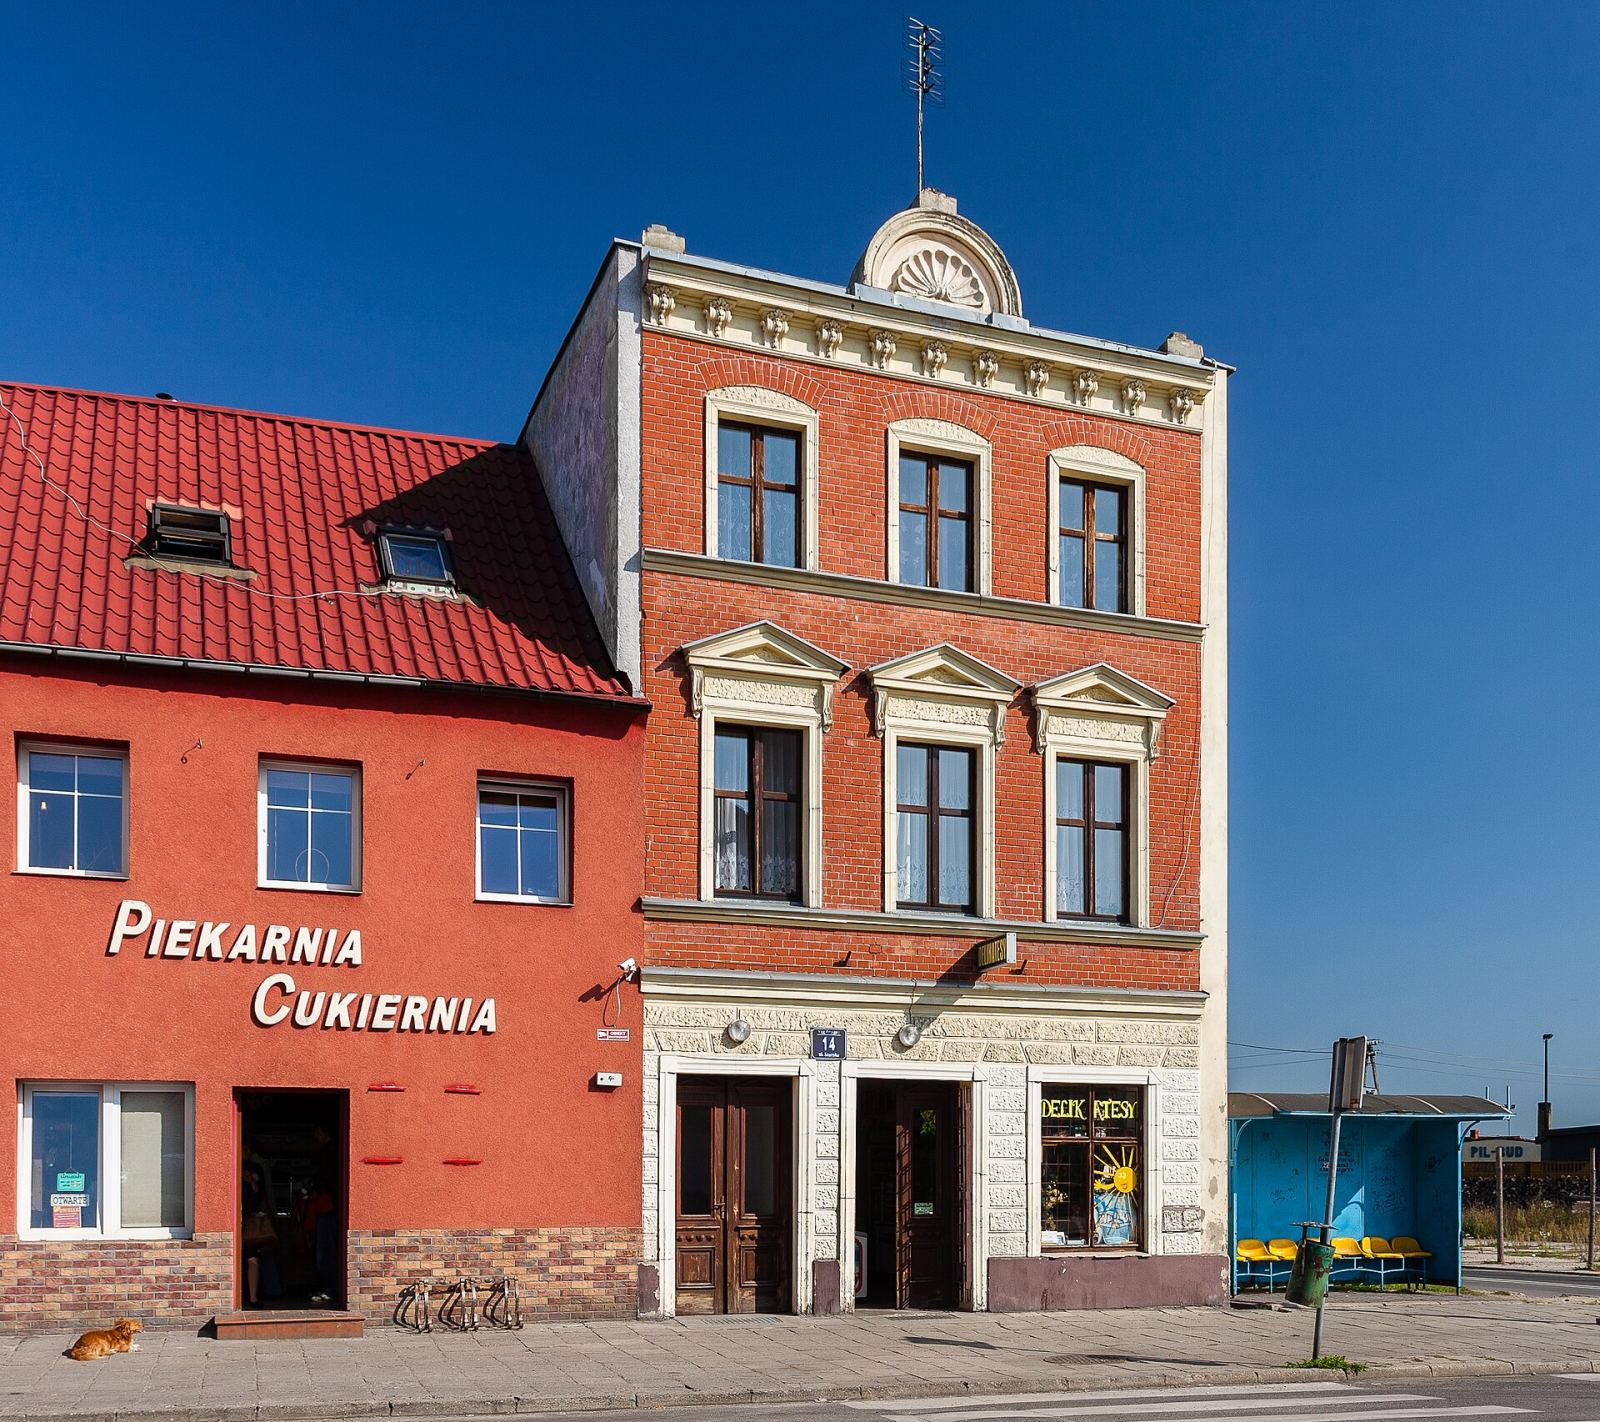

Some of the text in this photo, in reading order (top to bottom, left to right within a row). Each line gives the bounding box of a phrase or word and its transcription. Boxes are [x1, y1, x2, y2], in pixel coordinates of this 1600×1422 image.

[108, 899, 363, 965] PIEKARNIA
[253, 972, 497, 1033] CUKIERNIA
[822, 1036, 836, 1051] 14
[53, 1196, 88, 1205] OTWARTE
